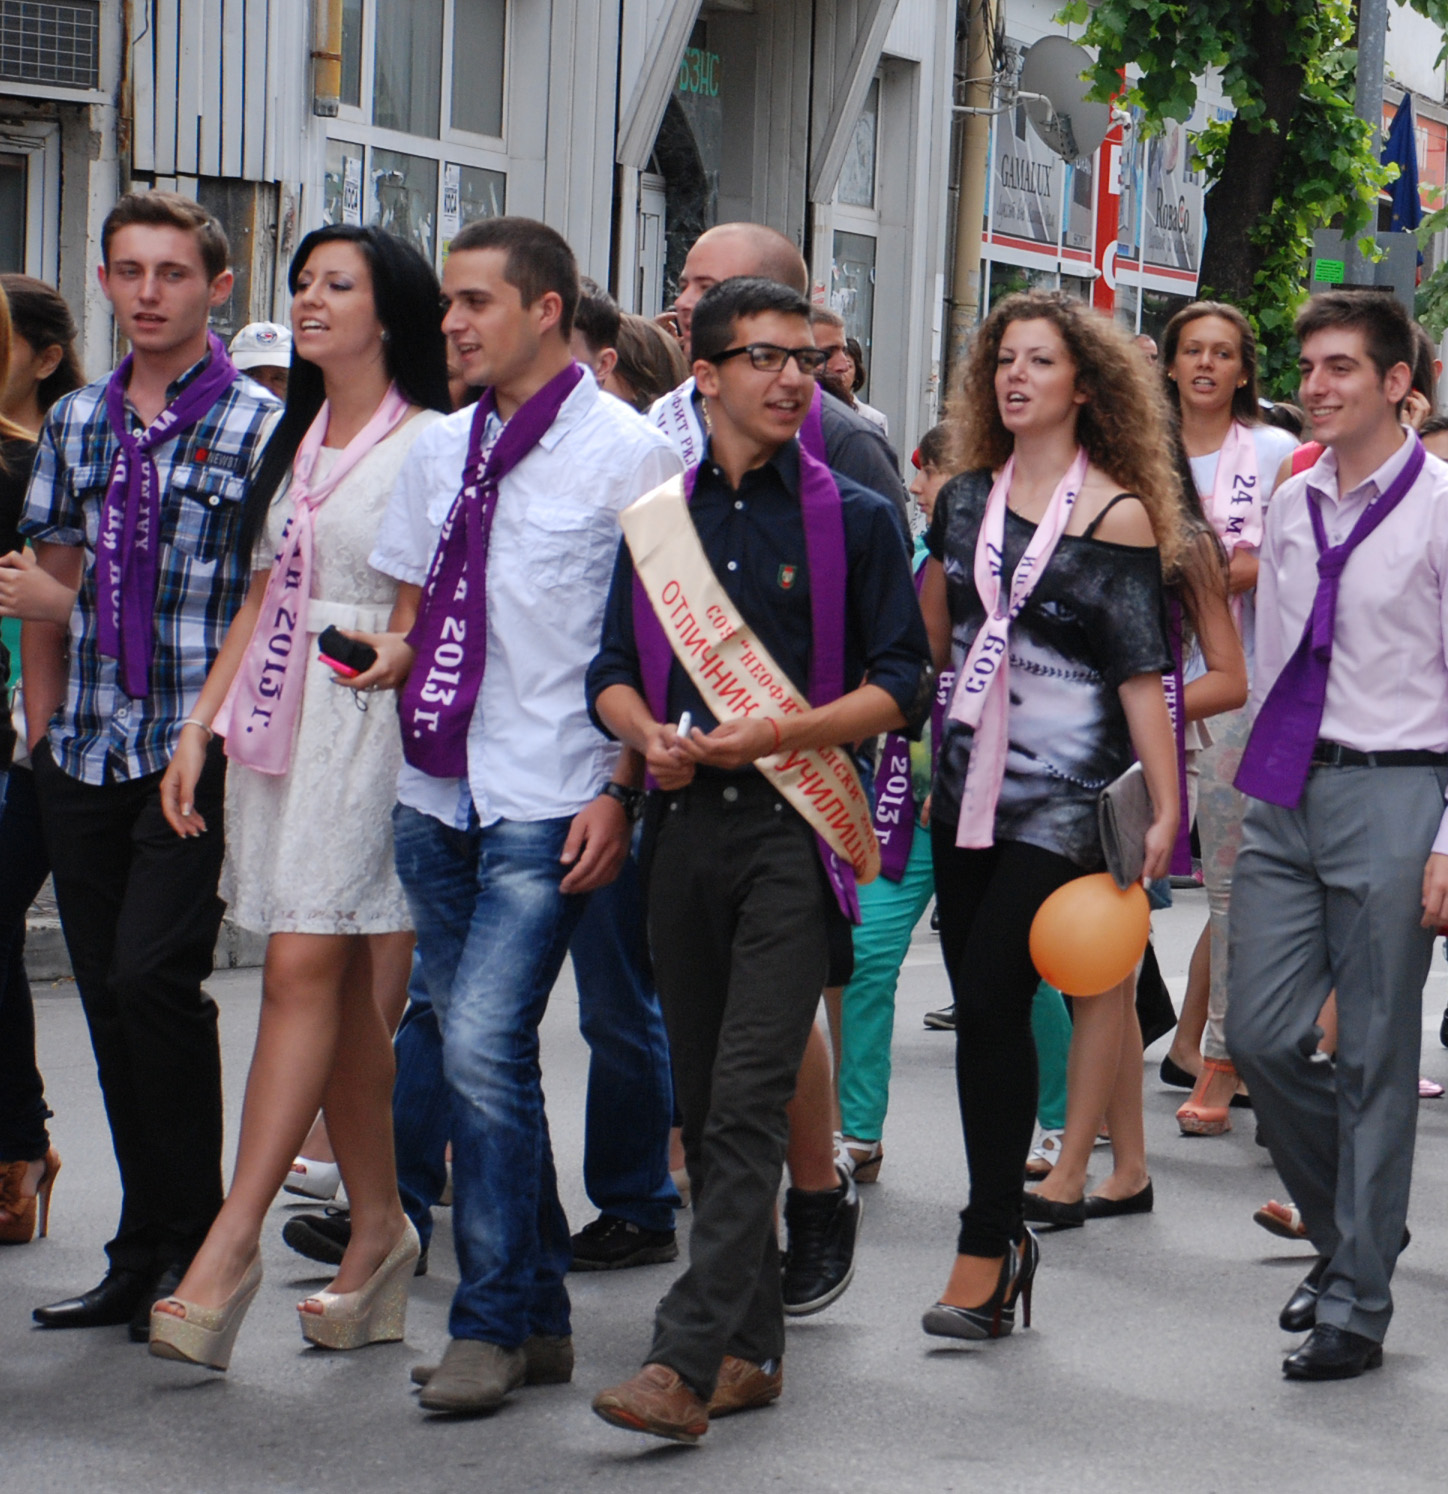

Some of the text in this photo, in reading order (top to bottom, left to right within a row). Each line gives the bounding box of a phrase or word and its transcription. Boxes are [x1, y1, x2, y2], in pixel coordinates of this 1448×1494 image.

[1001, 154, 1052, 197] GAMALUX
[258, 606, 297, 700] 2013
[420, 615, 467, 706] 2013
[661, 580, 760, 718] ОТЛИЧНИК
[705, 604, 738, 643] СОУ
[876, 755, 908, 825] 2013
